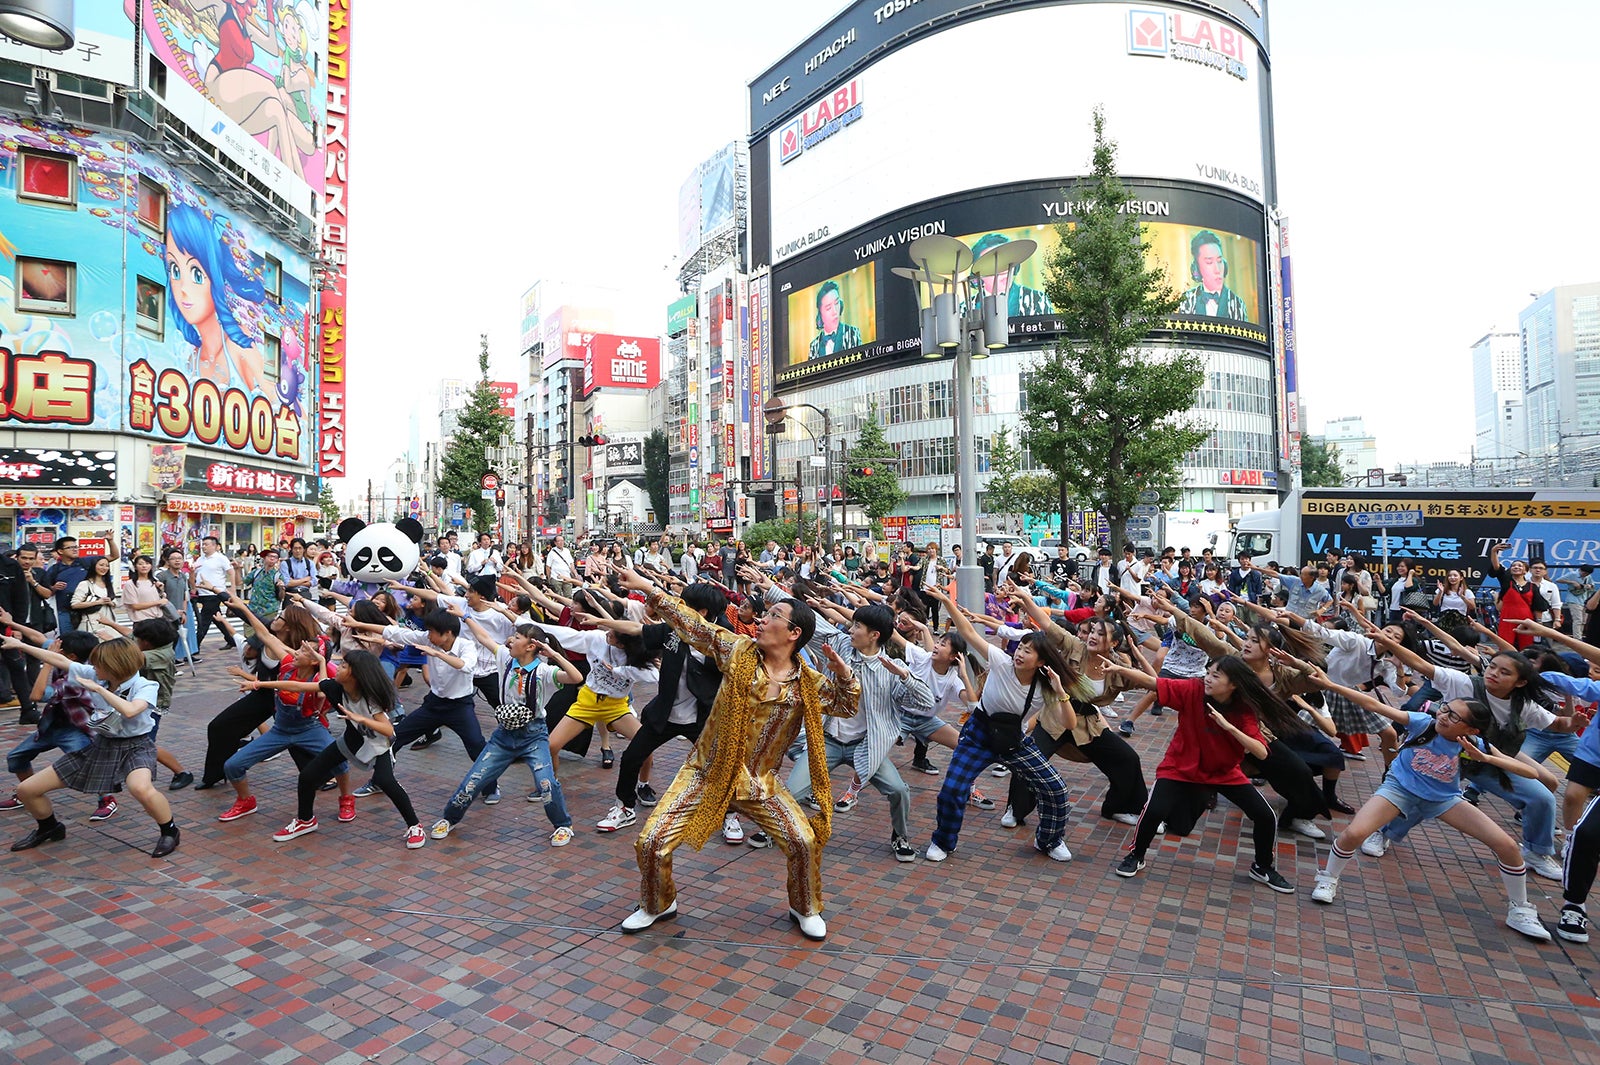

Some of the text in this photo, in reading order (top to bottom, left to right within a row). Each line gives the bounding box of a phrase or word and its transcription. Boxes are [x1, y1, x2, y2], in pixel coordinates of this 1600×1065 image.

[804, 28, 856, 75] HITACHI
[1174, 14, 1243, 61] LABI
[1176, 44, 1226, 69] SHINJUKU
[763, 76, 791, 105] NEC
[802, 80, 857, 137] LABI
[804, 118, 840, 150] SHINJUKU
[1196, 163, 1261, 196] YUNIKA BLDG.
[776, 225, 831, 259] YUNIKA BLDG.
[854, 219, 946, 261] YUNIKA VISION
[1020, 322, 1046, 333] feat.
[322, 306, 344, 383] パチンコ
[896, 337, 923, 351] BIGBAN
[611, 358, 647, 378] GAME
[321, 391, 345, 474] エスパス
[209, 464, 296, 496] 新宿地区
[1231, 470, 1262, 485] LABI
[169, 500, 200, 511] ありがとう
[1343, 547, 1368, 556] from
[1371, 535, 1461, 553] BIG
[1371, 549, 1461, 560] BANG
[1427, 568, 1446, 577] on
[1460, 566, 1481, 578] ale
